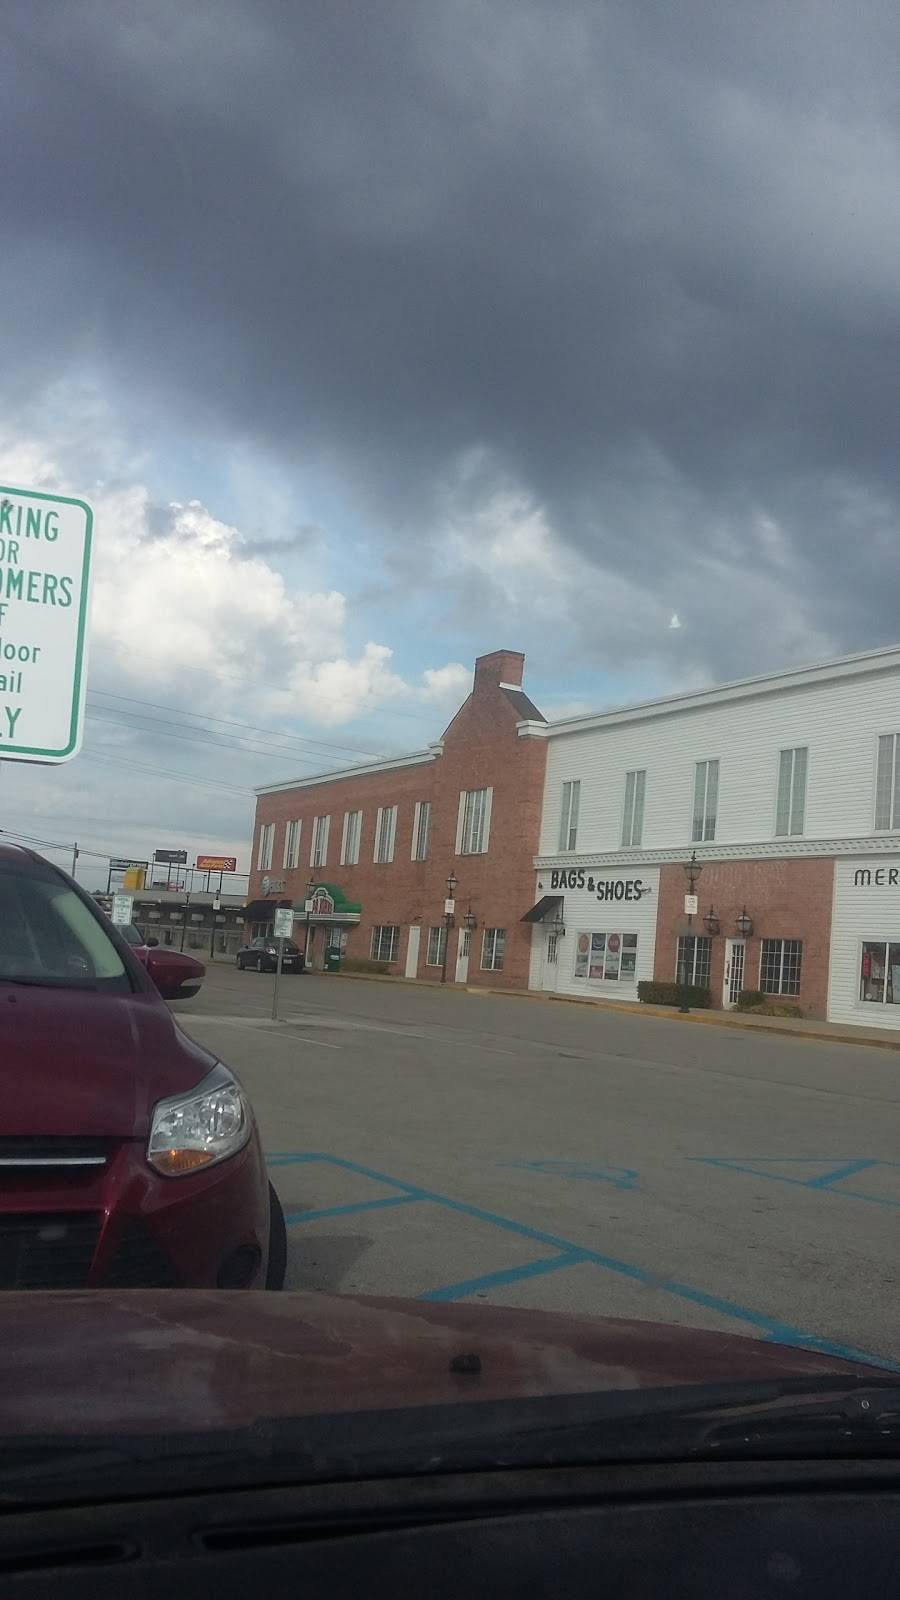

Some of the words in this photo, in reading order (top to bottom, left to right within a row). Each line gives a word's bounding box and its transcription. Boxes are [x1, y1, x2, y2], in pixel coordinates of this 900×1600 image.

[0, 567, 73, 607] MERS
[551, 869, 585, 889] BAGS
[587, 877, 595, 892] &
[597, 880, 642, 900] SHOES
[854, 868, 899, 886] MER
